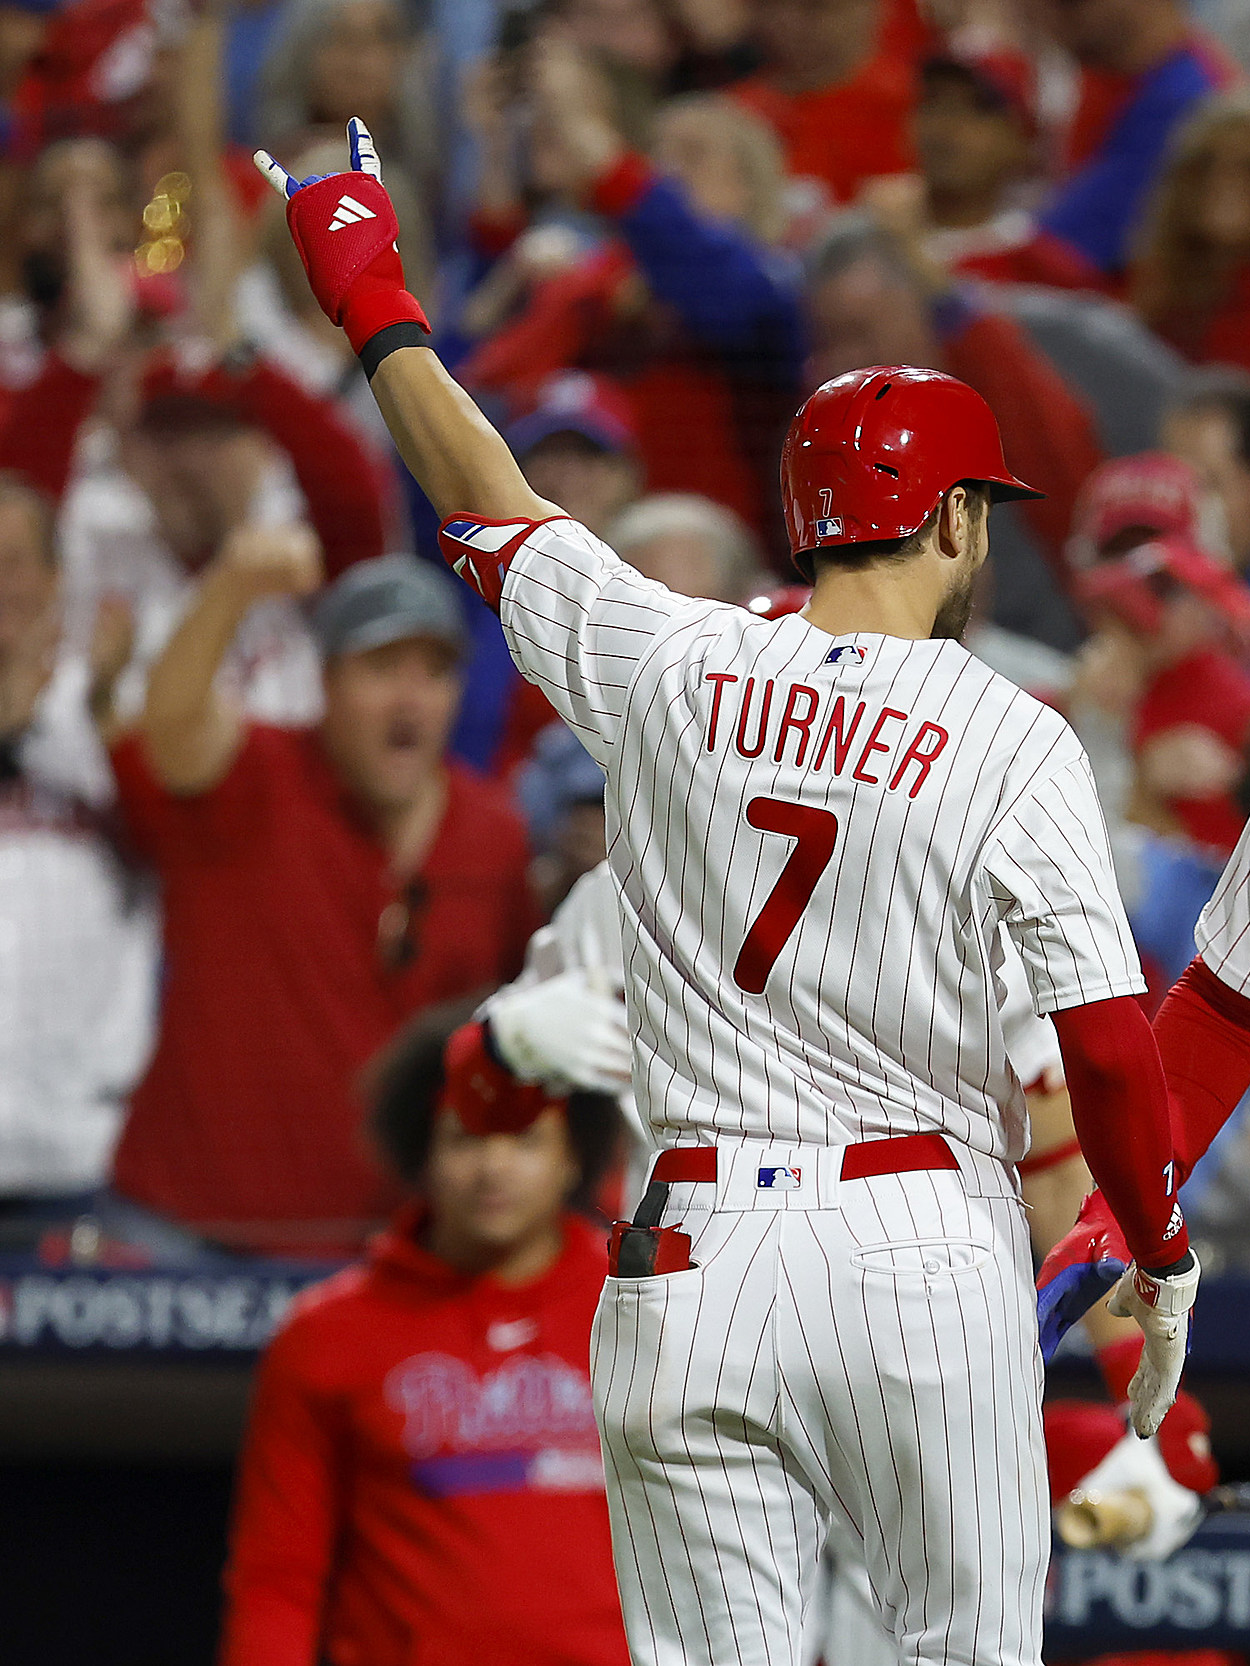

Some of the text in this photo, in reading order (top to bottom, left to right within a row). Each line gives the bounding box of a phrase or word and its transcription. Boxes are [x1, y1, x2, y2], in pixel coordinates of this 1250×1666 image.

[819, 488, 833, 518] 7
[704, 672, 950, 800] TURNER
[733, 796, 839, 995] 7
[1162, 1160, 1174, 1196] 7
